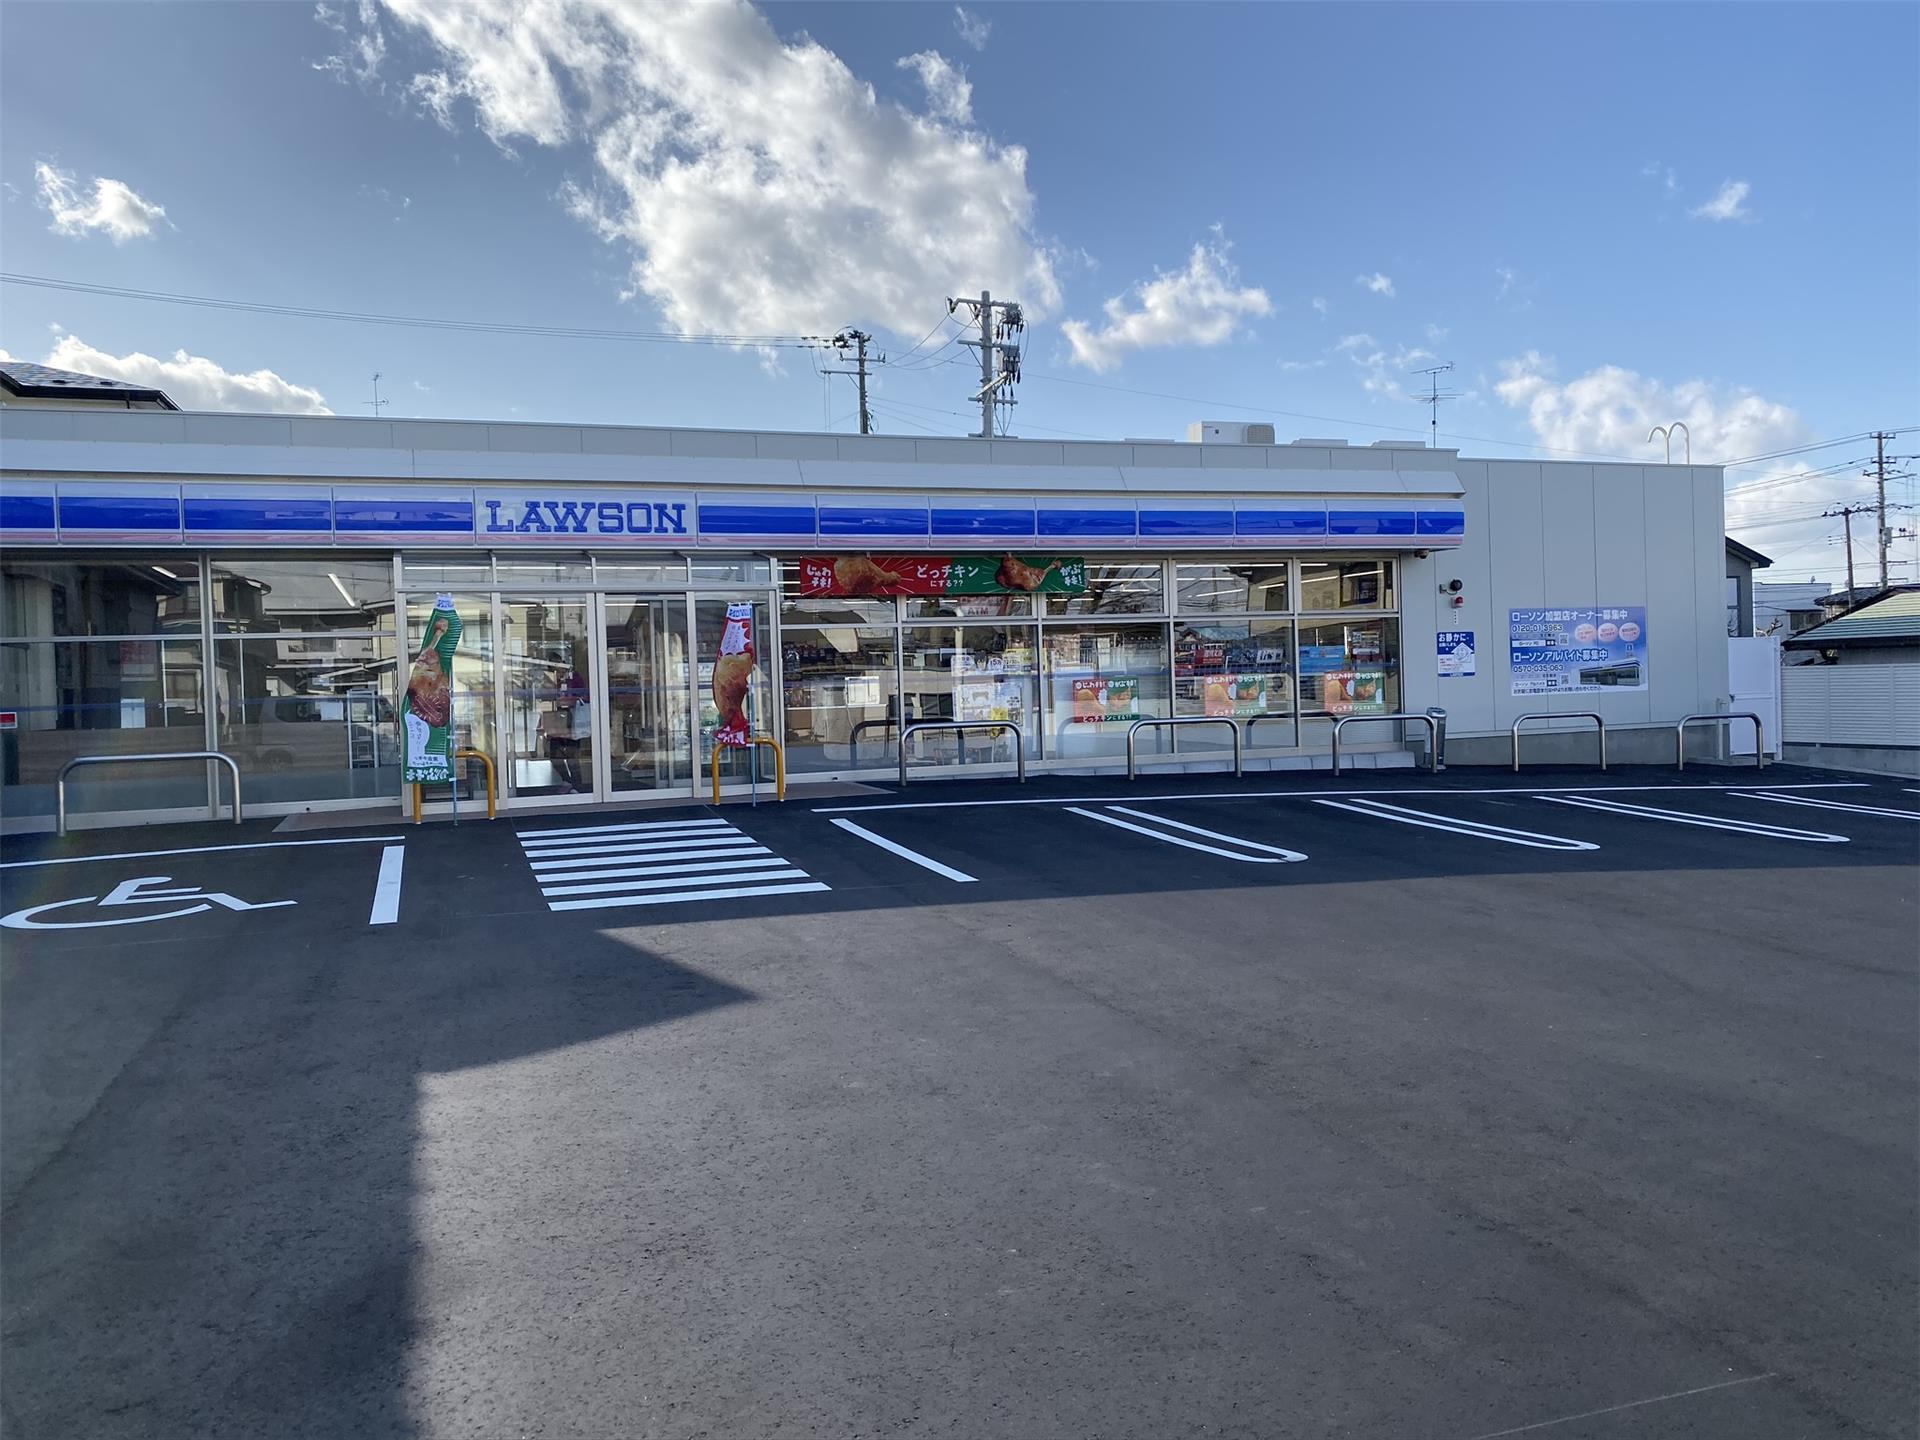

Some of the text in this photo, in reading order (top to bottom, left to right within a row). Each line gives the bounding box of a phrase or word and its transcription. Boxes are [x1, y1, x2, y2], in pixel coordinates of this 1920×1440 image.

[486, 500, 687, 534] LAWSON
[916, 564, 979, 579] どっチキン
[930, 579, 964, 588] にする??
[967, 607, 989, 615] ATM
[1513, 649, 1608, 662] ローソンアルバイト募集中
